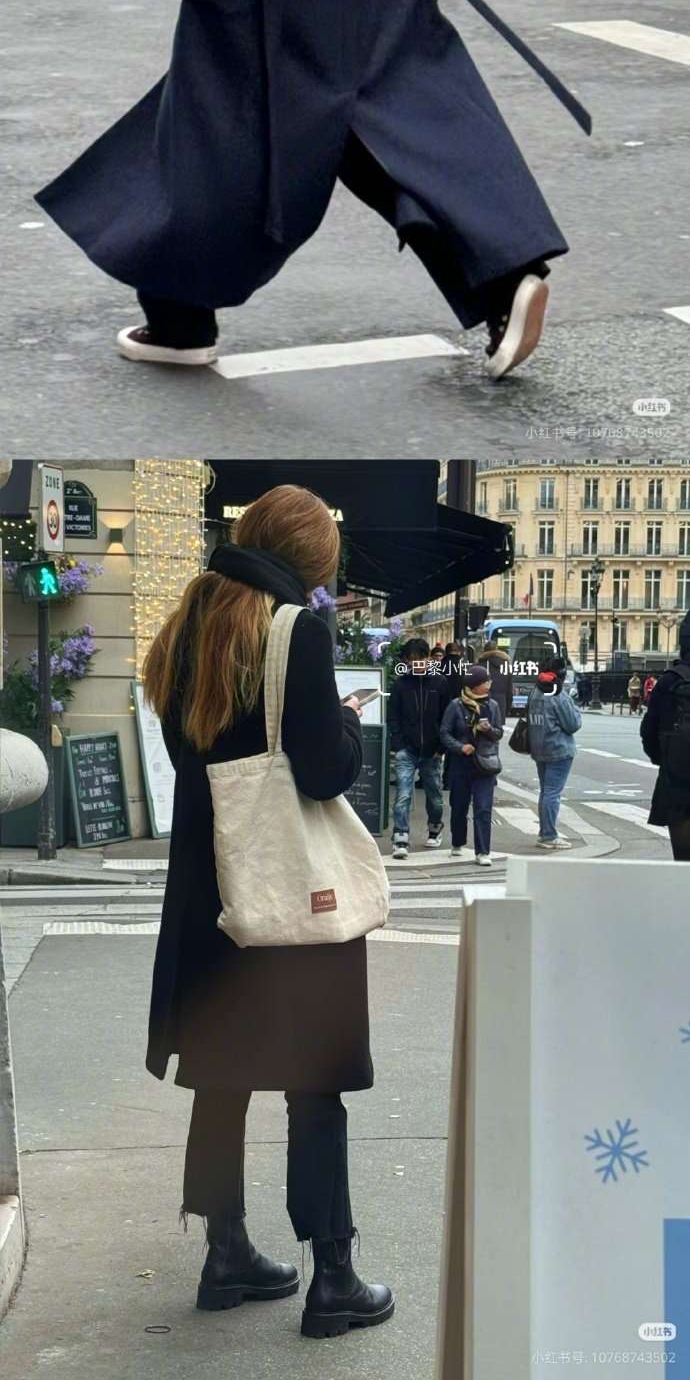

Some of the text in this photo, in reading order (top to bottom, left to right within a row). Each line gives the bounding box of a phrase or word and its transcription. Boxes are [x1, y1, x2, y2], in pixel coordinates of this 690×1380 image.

[45, 475, 60, 489] ZONE
[68, 504, 78, 512] RUE
[50, 512, 57, 528] 30
[79, 743, 94, 754] HAPPY
